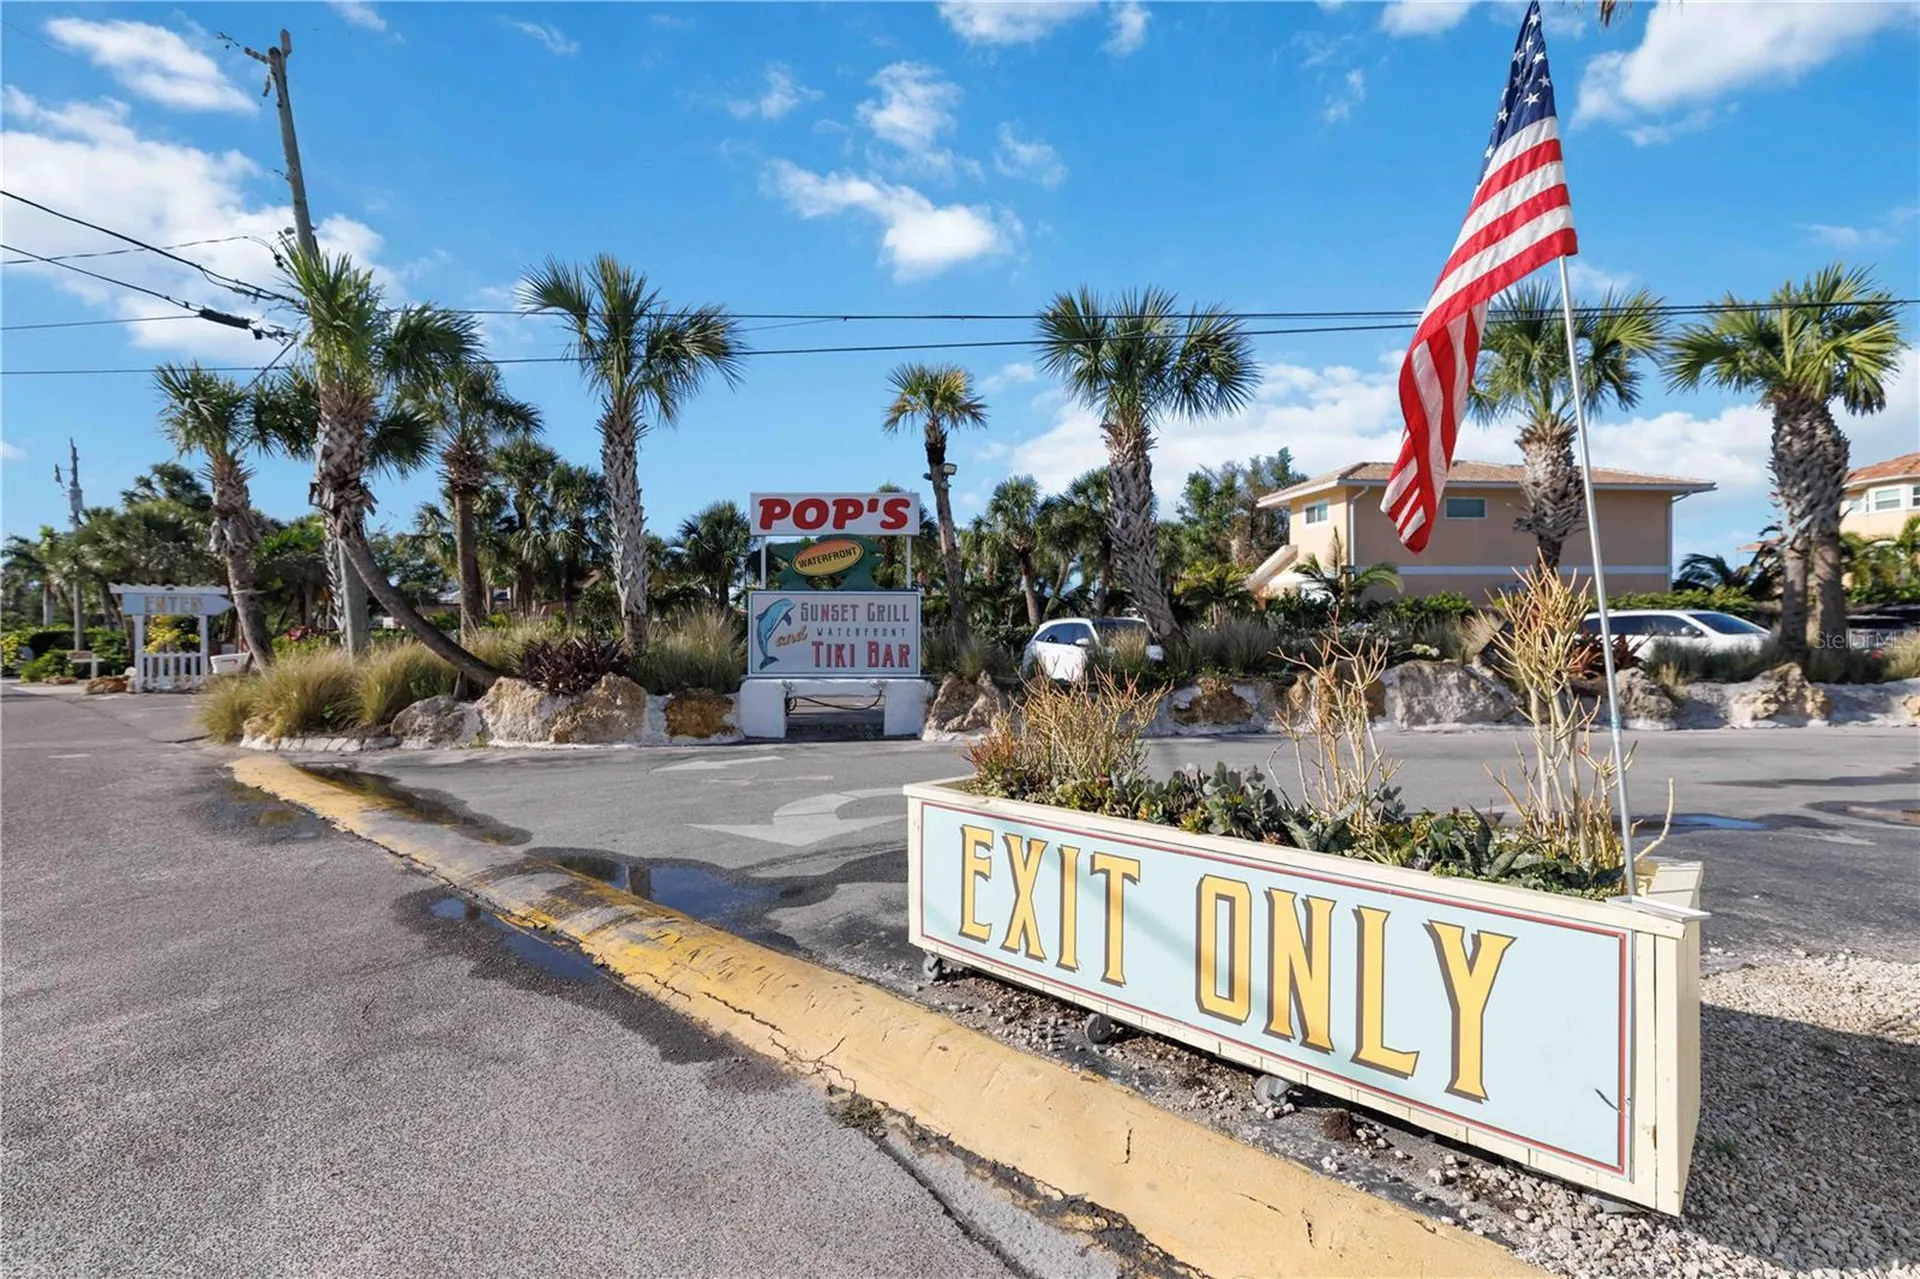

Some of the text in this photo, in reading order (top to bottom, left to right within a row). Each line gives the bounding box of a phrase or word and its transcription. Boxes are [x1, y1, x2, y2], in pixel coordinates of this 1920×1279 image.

[759, 497, 911, 531] POP'S
[797, 546, 858, 569] WATERFRONT
[144, 595, 204, 614] ENTER
[800, 601, 910, 622] SUNSET GRILL
[775, 625, 809, 647] and
[816, 627, 907, 637] WATERFRONT
[811, 640, 911, 668] TIKI BAR
[958, 823, 1517, 1104] EXIT ONLY
